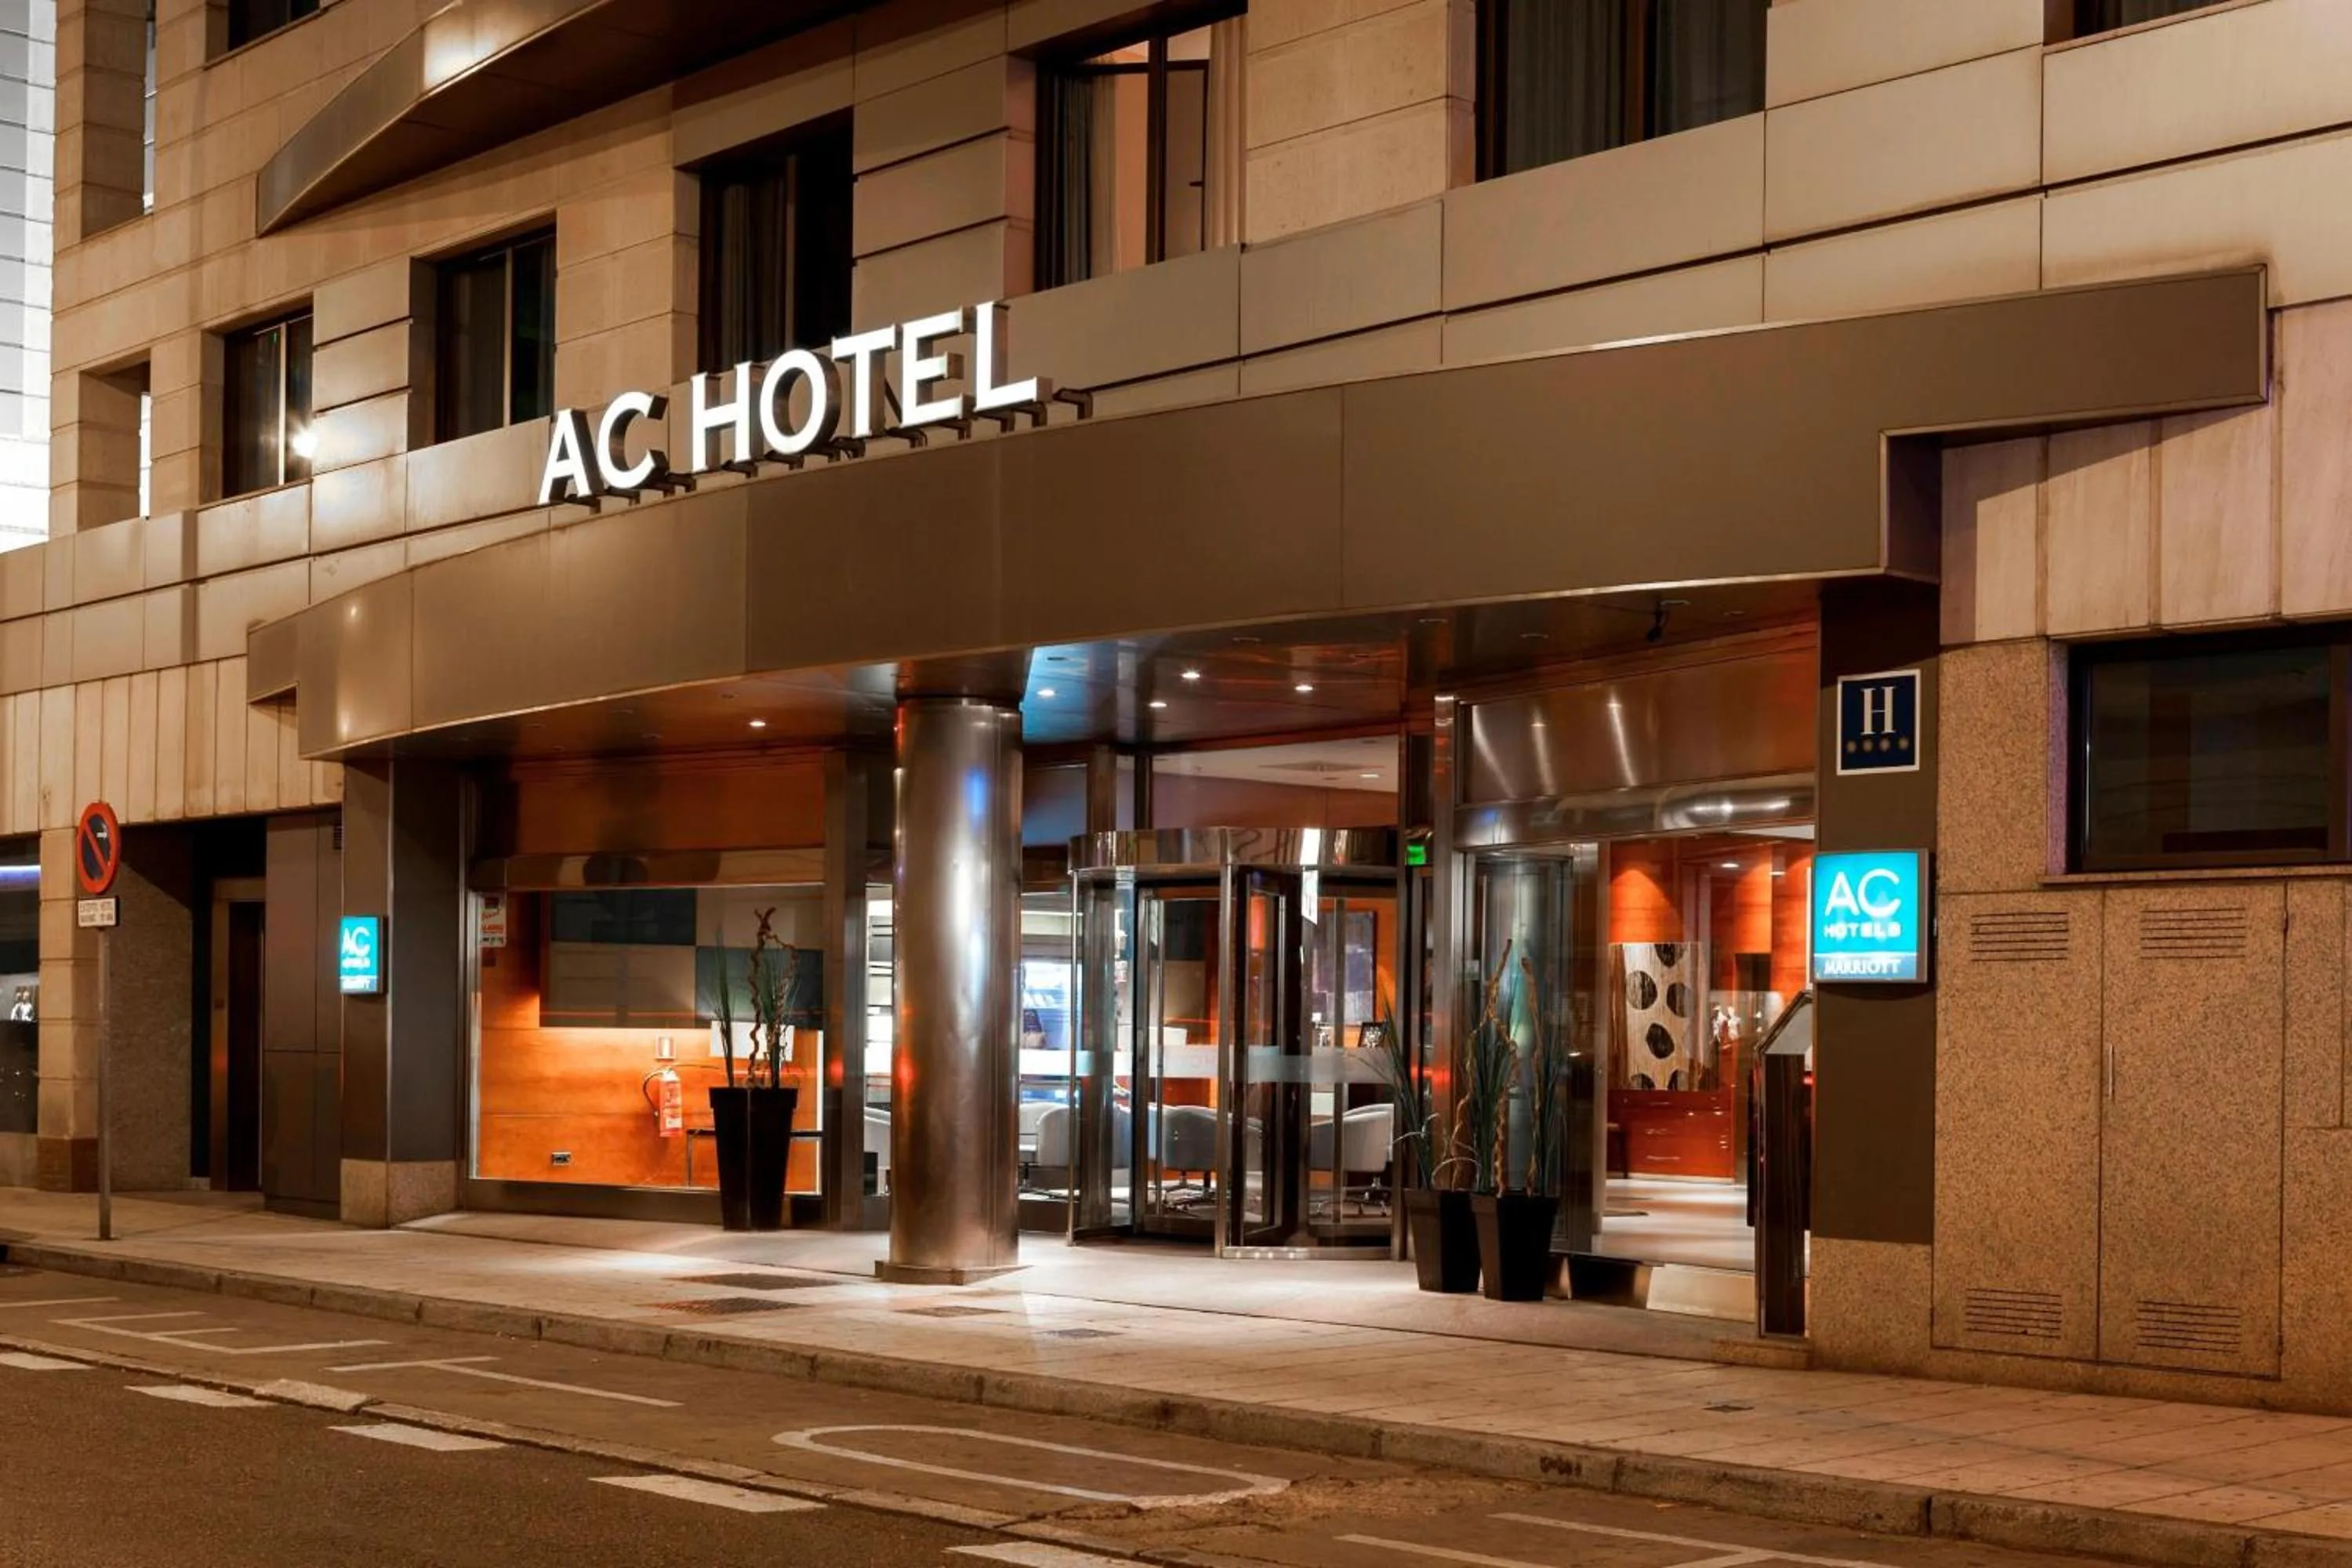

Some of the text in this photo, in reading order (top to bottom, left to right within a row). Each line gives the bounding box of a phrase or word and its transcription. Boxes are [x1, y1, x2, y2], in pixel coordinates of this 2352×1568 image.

[538, 301, 1041, 504] AC HOTEL
[1860, 686, 1896, 735] H
[1824, 869, 1901, 918] AC
[342, 927, 371, 957] AC
[1824, 921, 1901, 939] HOTELS
[1824, 959, 1901, 975] MARRIOTT
